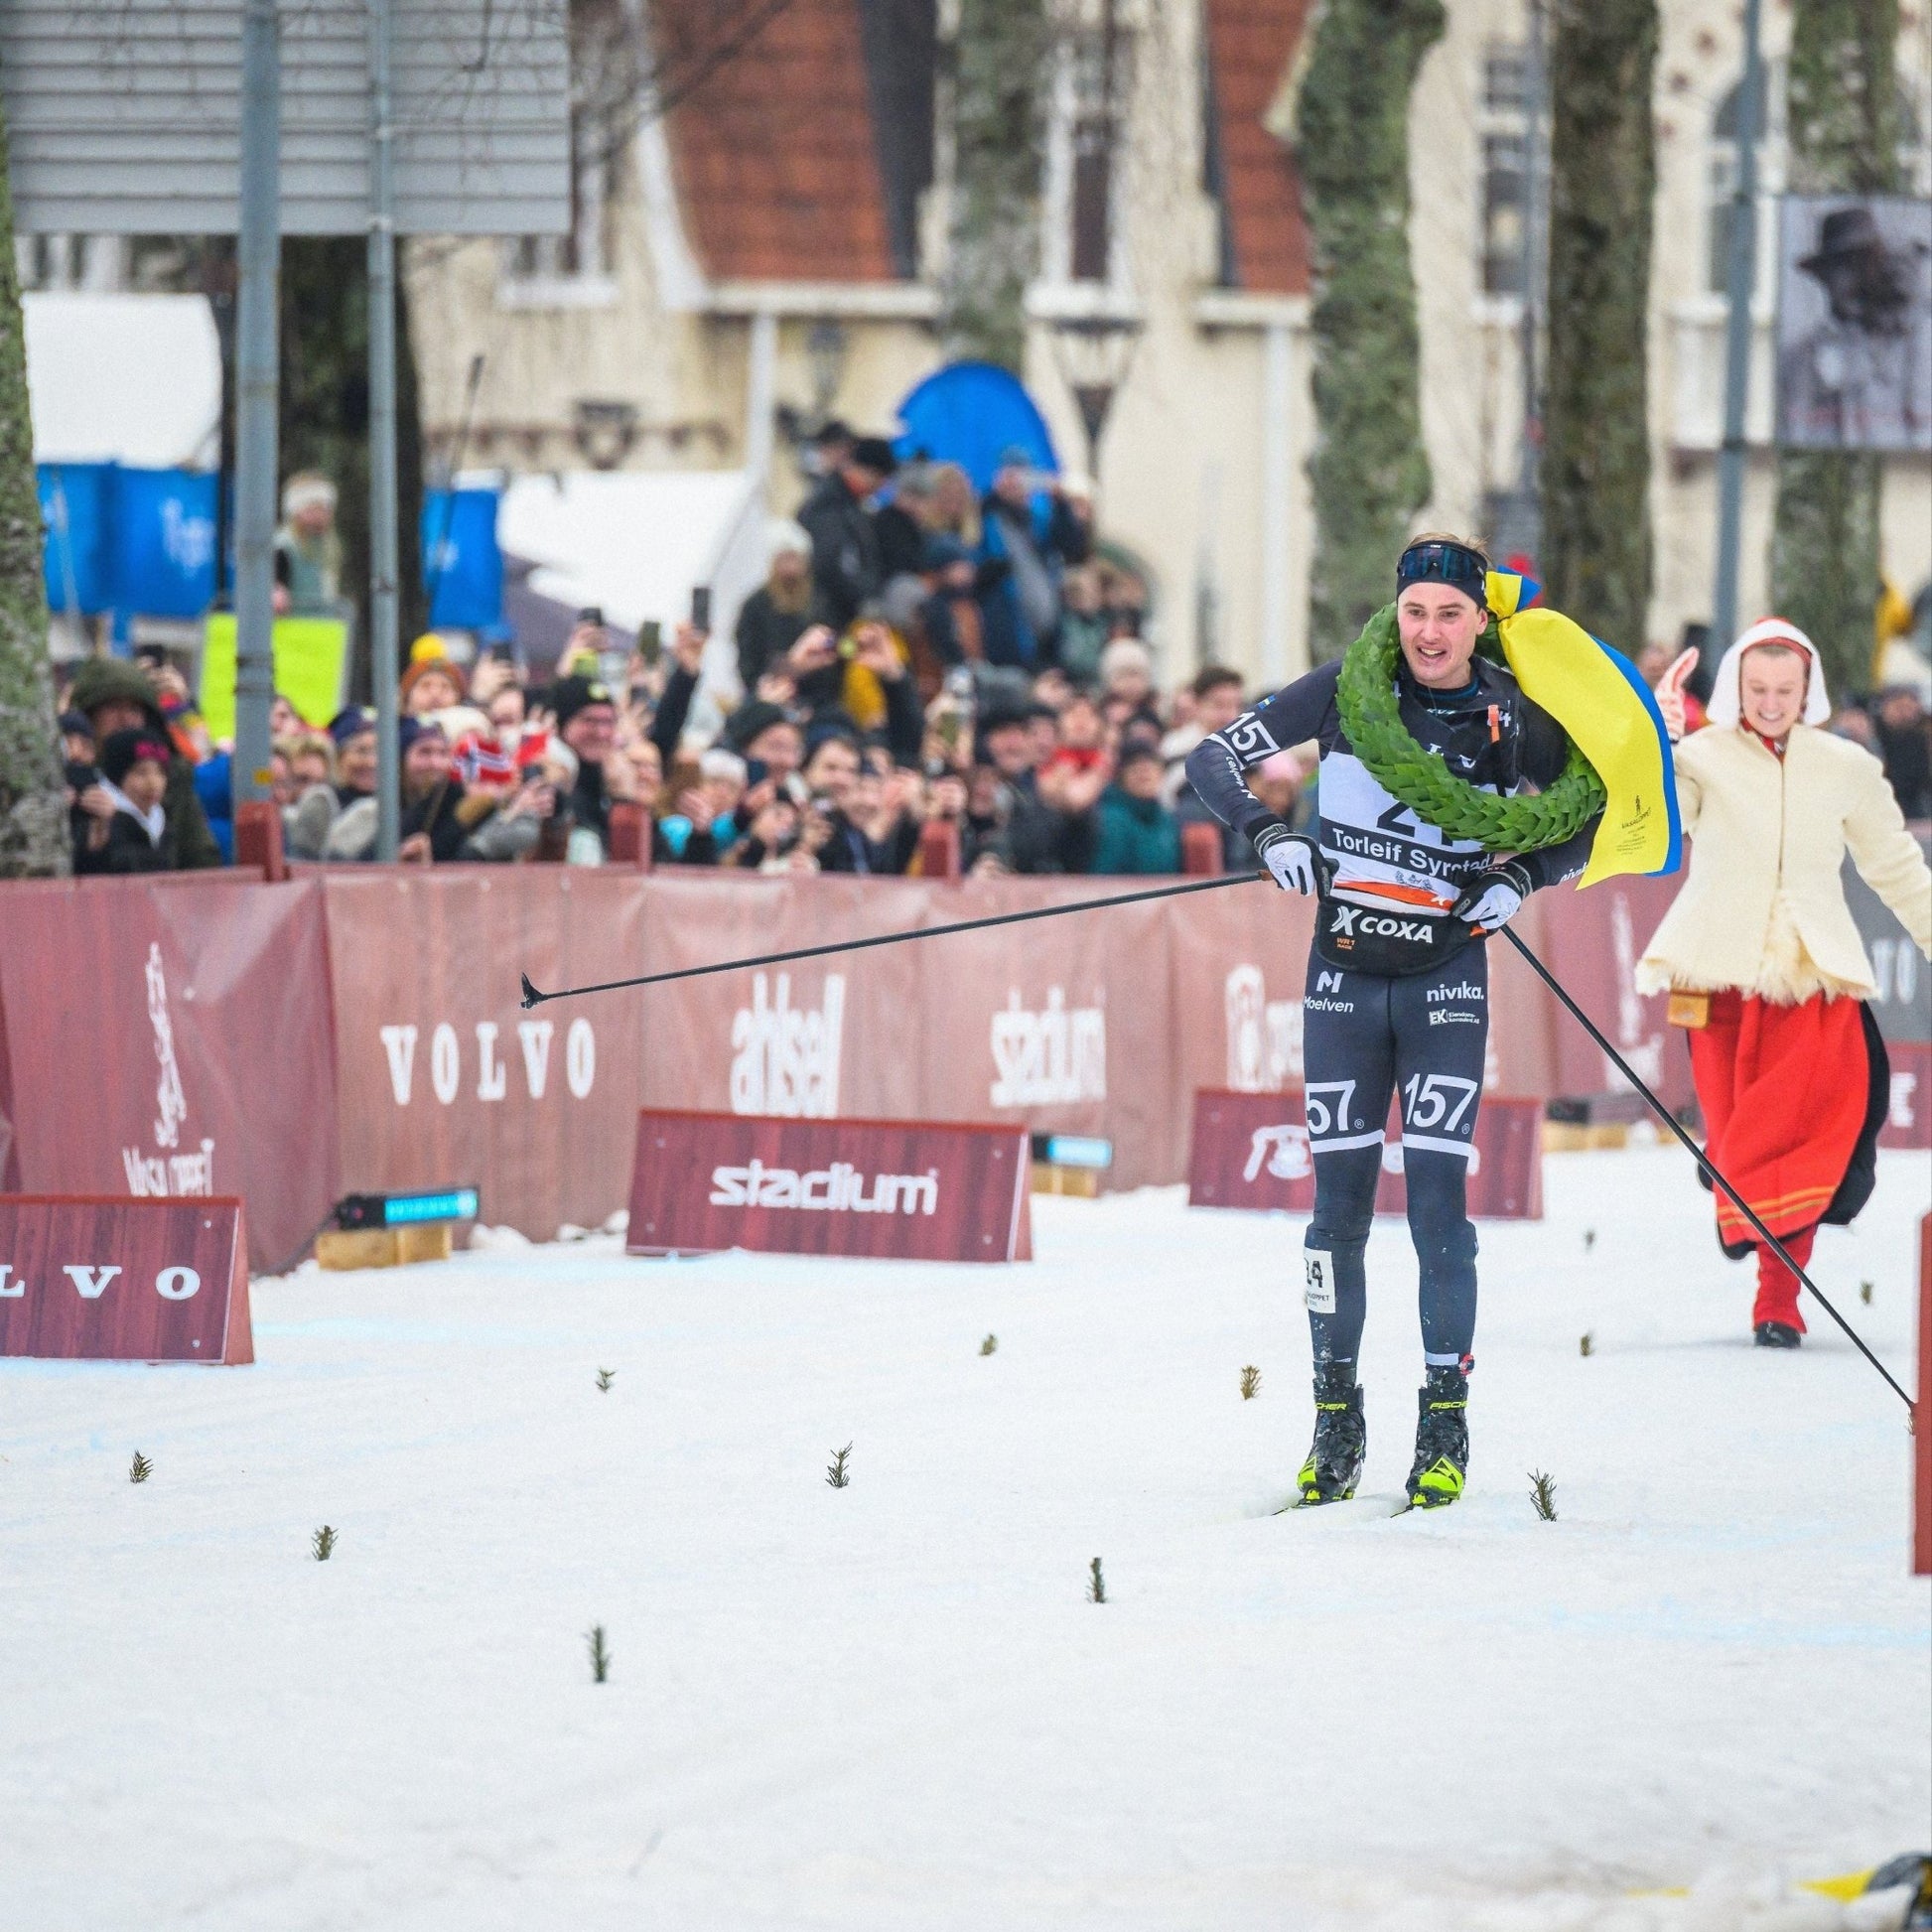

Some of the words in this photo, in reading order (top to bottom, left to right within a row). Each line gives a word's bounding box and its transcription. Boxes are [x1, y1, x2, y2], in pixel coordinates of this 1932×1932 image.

[1224, 711, 1281, 761] 157
[1332, 827, 1402, 863] Torleif
[1359, 914, 1434, 944] COXA
[1304, 996, 1354, 1014] Moelven
[1427, 981, 1484, 1003] nivika.
[380, 1017, 596, 1105] VOLVO
[1405, 1073, 1478, 1132] 157
[709, 1159, 938, 1215] stadium
